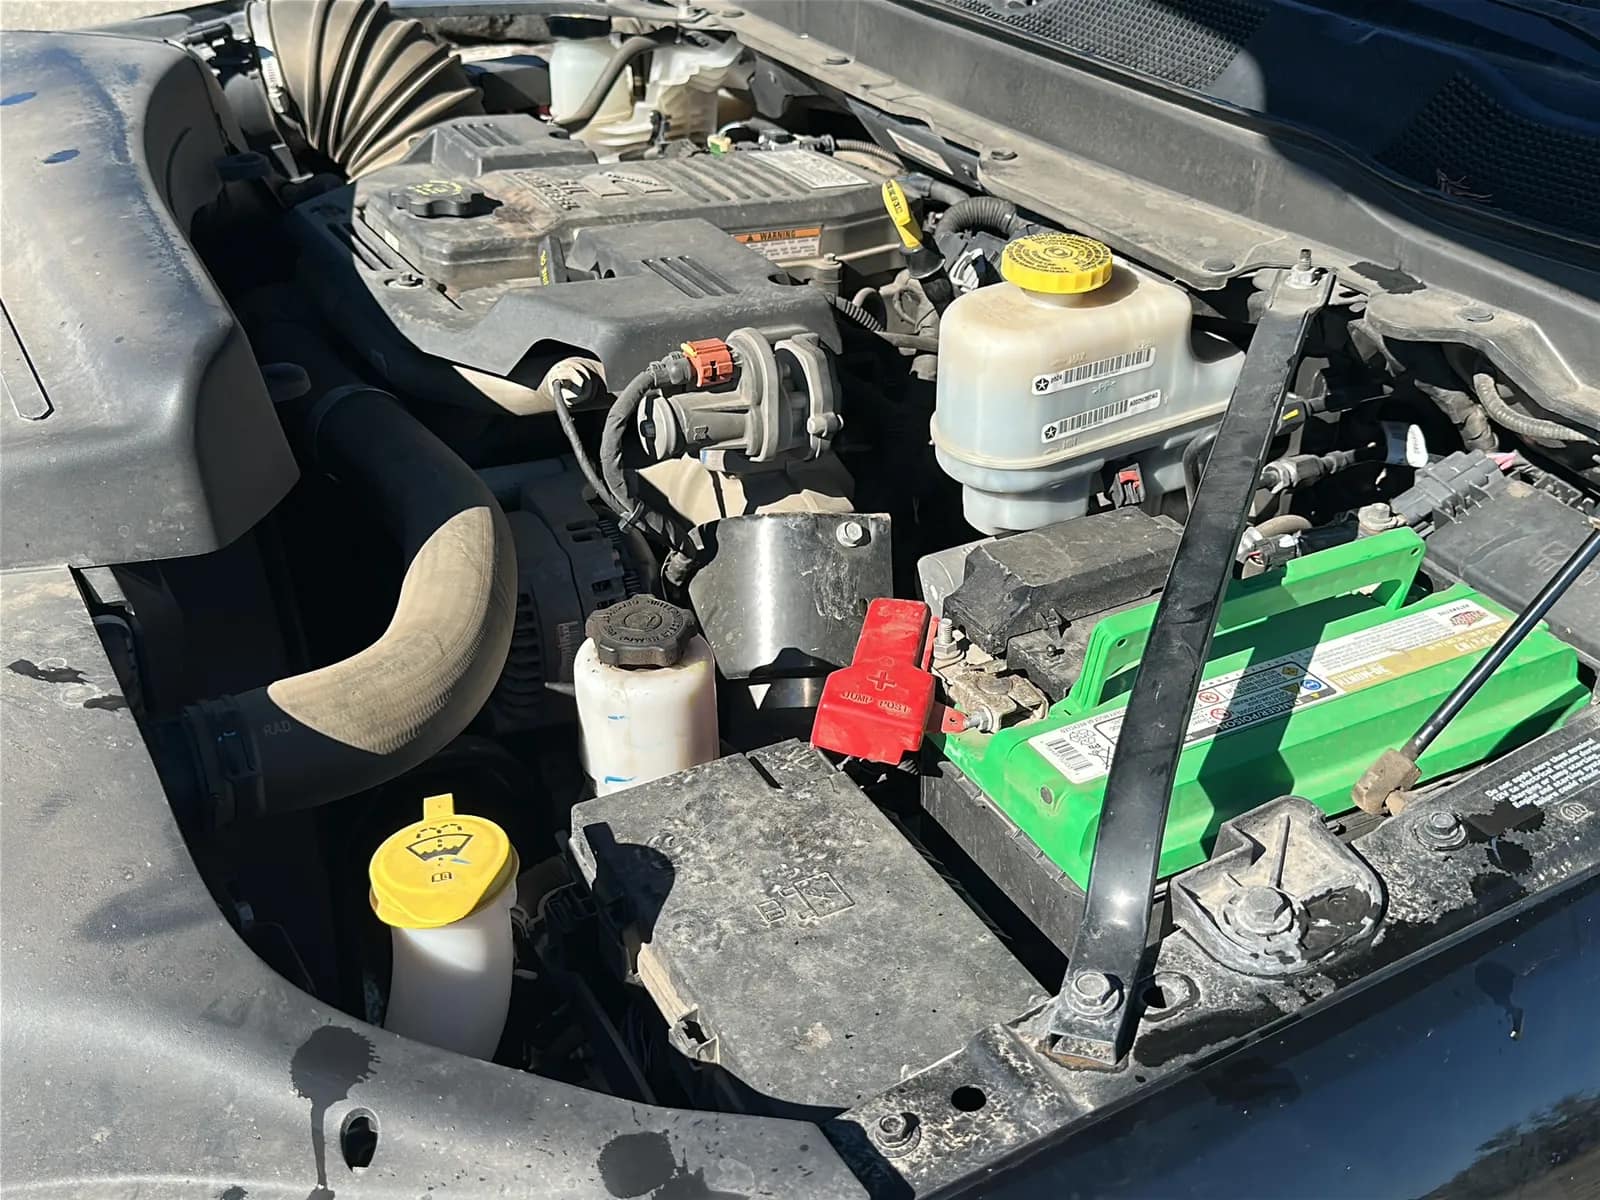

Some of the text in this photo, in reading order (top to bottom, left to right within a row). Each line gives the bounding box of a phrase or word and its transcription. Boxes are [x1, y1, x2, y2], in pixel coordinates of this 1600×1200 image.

[760, 230, 796, 241] WARNING
[841, 691, 912, 714] JUMP POST
[1485, 789, 1498, 797] Do
[1498, 781, 1513, 790] not
[1512, 771, 1533, 783] apply
[1532, 761, 1551, 773] more
[1549, 752, 1569, 763] than
[1492, 790, 1509, 802] 12V
